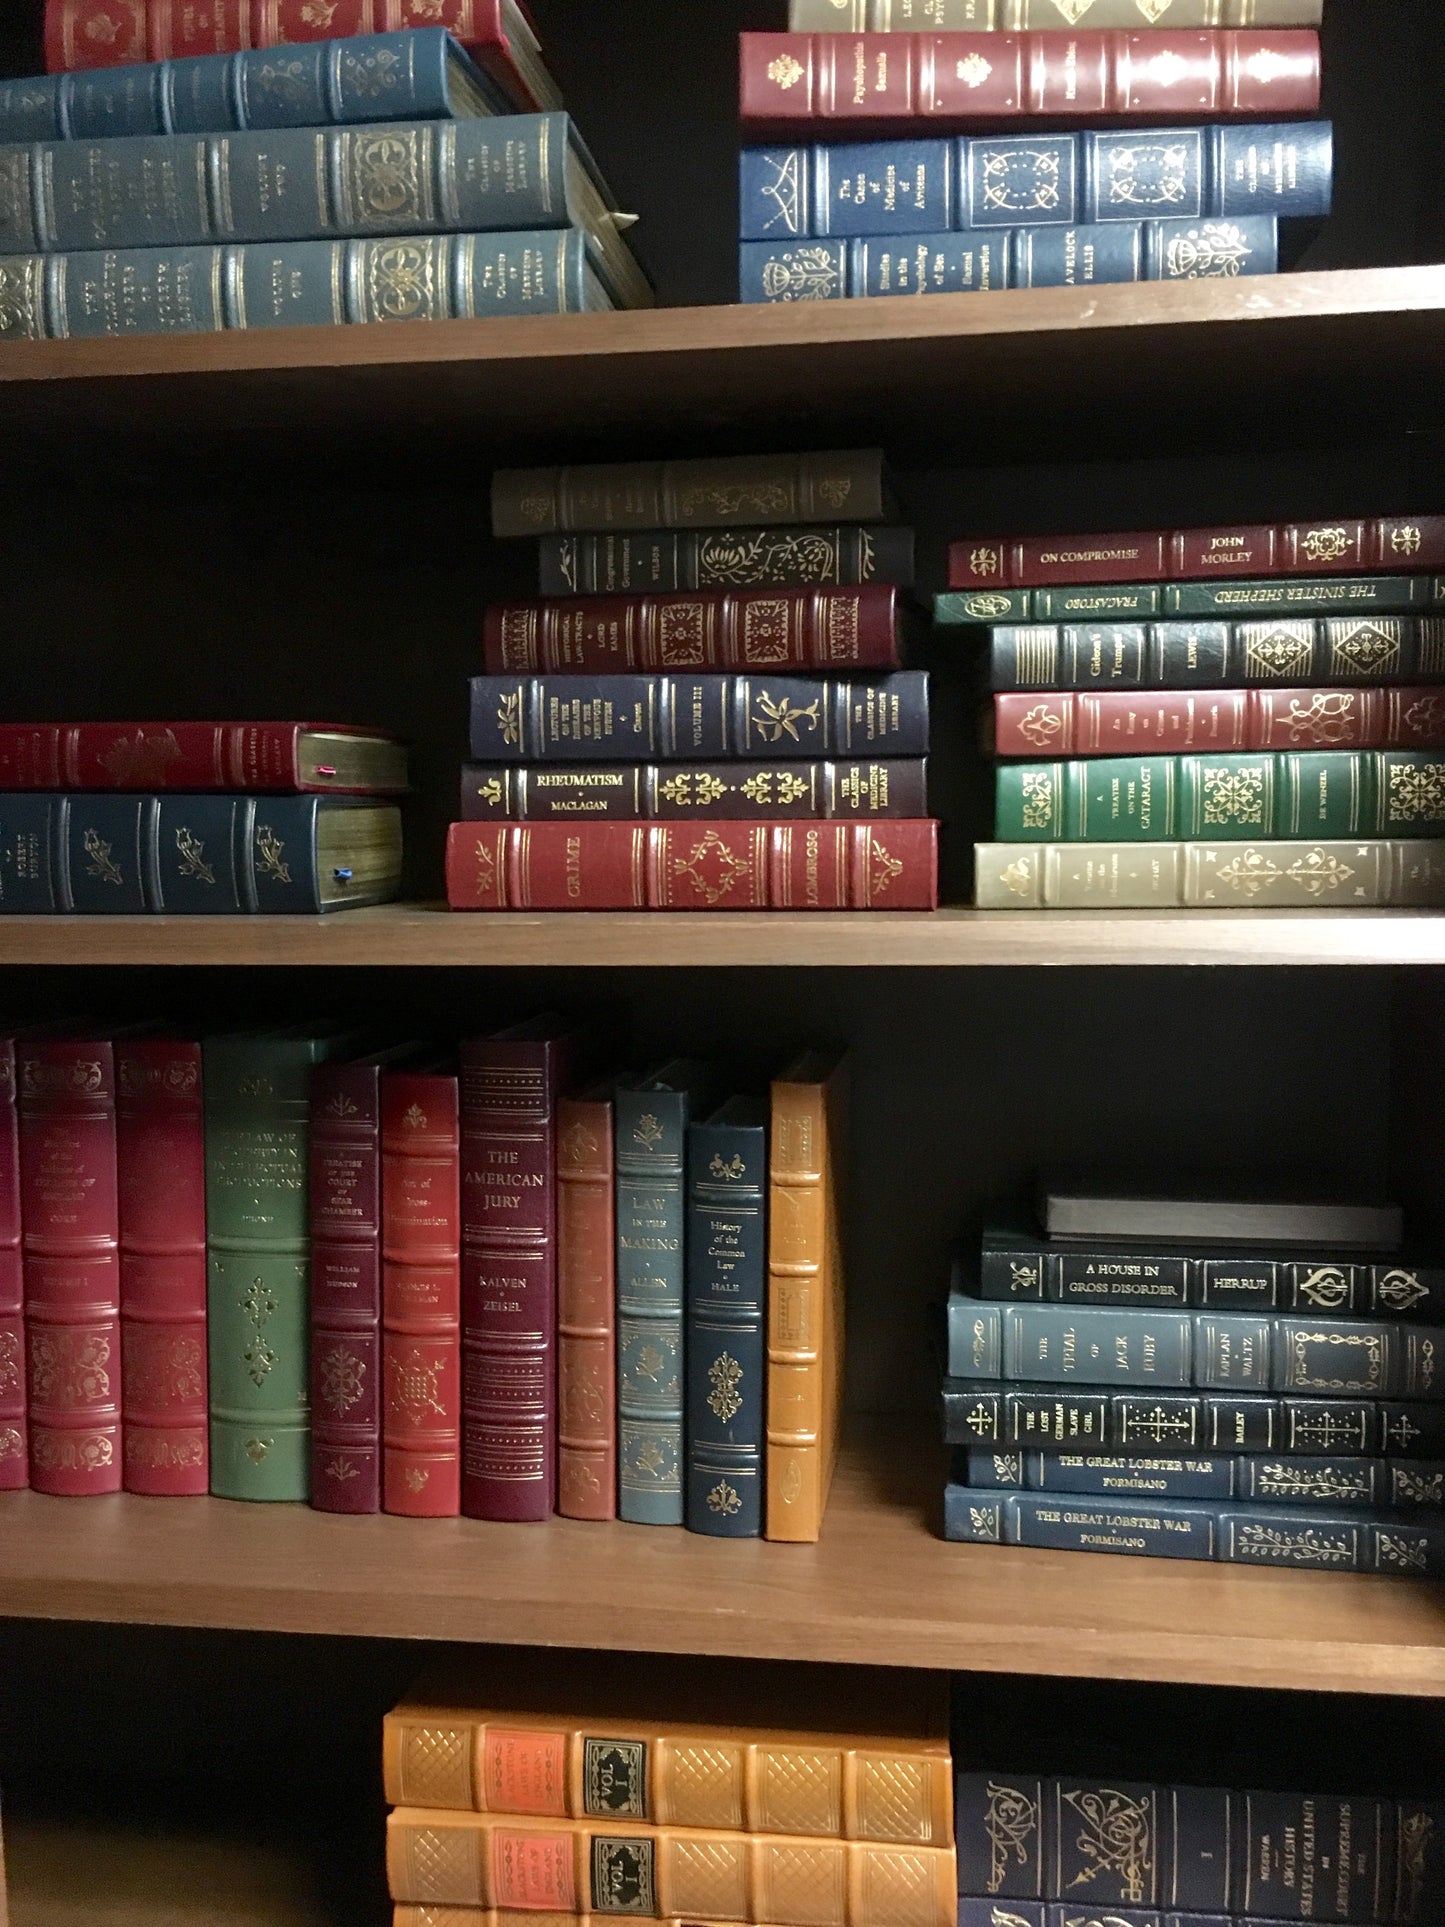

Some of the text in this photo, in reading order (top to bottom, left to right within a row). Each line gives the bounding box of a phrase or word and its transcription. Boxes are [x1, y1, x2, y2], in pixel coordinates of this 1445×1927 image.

[875, 52, 887, 91] Sexualis
[840, 179, 850, 199] The
[855, 173, 865, 204] Canon
[869, 181, 880, 193] of
[884, 165, 895, 211] Medicine
[899, 181, 910, 192] of
[880, 253, 890, 289] Studies
[897, 258, 908, 286] in the
[933, 254, 944, 285] of Sex
[962, 251, 973, 285] Sexual
[1084, 245, 1094, 279] ELLIS
[1040, 549, 1139, 564] ON COMPROMISE
[1201, 551, 1253, 565] MORLEY
[1211, 537, 1245, 549] JOHN
[606, 536, 616, 591] Congressional
[622, 538, 631, 588] Government
[652, 546, 660, 580] WILSON
[1064, 596, 1139, 609] FRACASTORO
[1214, 584, 1377, 603] THE SINISTER SHEPHERD
[563, 614, 571, 662] HISTORICAL
[597, 623, 606, 648] LORD
[610, 621, 618, 651] KAMES
[1090, 633, 1102, 677] Gideon's
[1111, 633, 1126, 678] Trumpet
[1187, 636, 1197, 669] LEWIS
[550, 697, 559, 741] LECTURES
[561, 704, 570, 736] ON THE
[572, 699, 581, 740] DISEASES
[583, 704, 592, 736] OF THE
[593, 698, 602, 740] NERVOUS
[604, 702, 613, 735] SYSTEM
[692, 686, 702, 746] VOLUME III
[867, 687, 875, 740] CLASSICS OF
[879, 692, 887, 735] MEDICINE
[891, 694, 899, 731] LIBRARY
[536, 774, 623, 787] RHEUMATISM
[841, 778, 850, 798] THE
[850, 767, 859, 809] CLASSICS
[860, 781, 869, 794] OF
[869, 764, 879, 810] MEDICINE
[879, 767, 888, 807] LIBRARY
[1319, 769, 1327, 806] WENZEL
[551, 800, 608, 811] MACLAGAN
[1111, 777, 1120, 819] TREATISE
[1127, 781, 1135, 814] ON THE
[1140, 765, 1151, 830] CATARACT
[566, 836, 581, 897] CRIME
[806, 830, 818, 904] LOMBROSO
[488, 1152, 519, 1164] THE
[327, 1179, 358, 1187] COURT
[465, 1172, 544, 1187] AMERICAN
[321, 1207, 364, 1216] CHAMBER
[331, 1197, 353, 1205] STAR
[484, 1195, 521, 1210] JURY
[632, 1198, 666, 1210] LAW
[646, 1220, 668, 1228] THE
[710, 1220, 742, 1235] History
[714, 1234, 739, 1244] of the
[620, 1236, 679, 1250] MAKING
[708, 1247, 746, 1258] Common
[326, 1265, 361, 1273] WILLIAM
[717, 1260, 736, 1270] Law
[1086, 1264, 1159, 1277] A HOUSE IN
[480, 1276, 527, 1288] KALVEN
[630, 1278, 668, 1287] ALLEN
[711, 1282, 740, 1292] HALE
[1069, 1282, 1178, 1297] GROSS DISORDER
[1213, 1278, 1267, 1290] HERRUP
[483, 1301, 523, 1312] ZEISEL
[1039, 1337, 1048, 1360] THE
[1063, 1327, 1075, 1372] TRIAL
[1091, 1343, 1100, 1358] OF
[1116, 1336, 1129, 1371] JACK
[1144, 1334, 1155, 1372] RUBY
[1220, 1333, 1230, 1378] KAPLAN
[1242, 1338, 1253, 1376] WALTZ
[1026, 1411, 1035, 1431] THE
[1040, 1410, 1049, 1433] LOST
[1055, 1403, 1064, 1440] GERMAN
[1069, 1408, 1078, 1436] SLAVE
[1083, 1411, 1093, 1433] GIRL
[1235, 1411, 1245, 1444] BAILEY
[1059, 1455, 1213, 1473] THE GREAT LOBSTER WAR
[1103, 1477, 1167, 1490] FORMISANO
[1036, 1510, 1192, 1532] THE GREAT LOBSTER WAR
[1080, 1534, 1146, 1548] FORMISANO
[600, 1763, 614, 1797] VOL
[1260, 1834, 1270, 1881] WARREN
[1284, 1826, 1296, 1888] HISTORY
[1300, 1800, 1315, 1916] UNITED STATES
[611, 1859, 624, 1894] VOL
